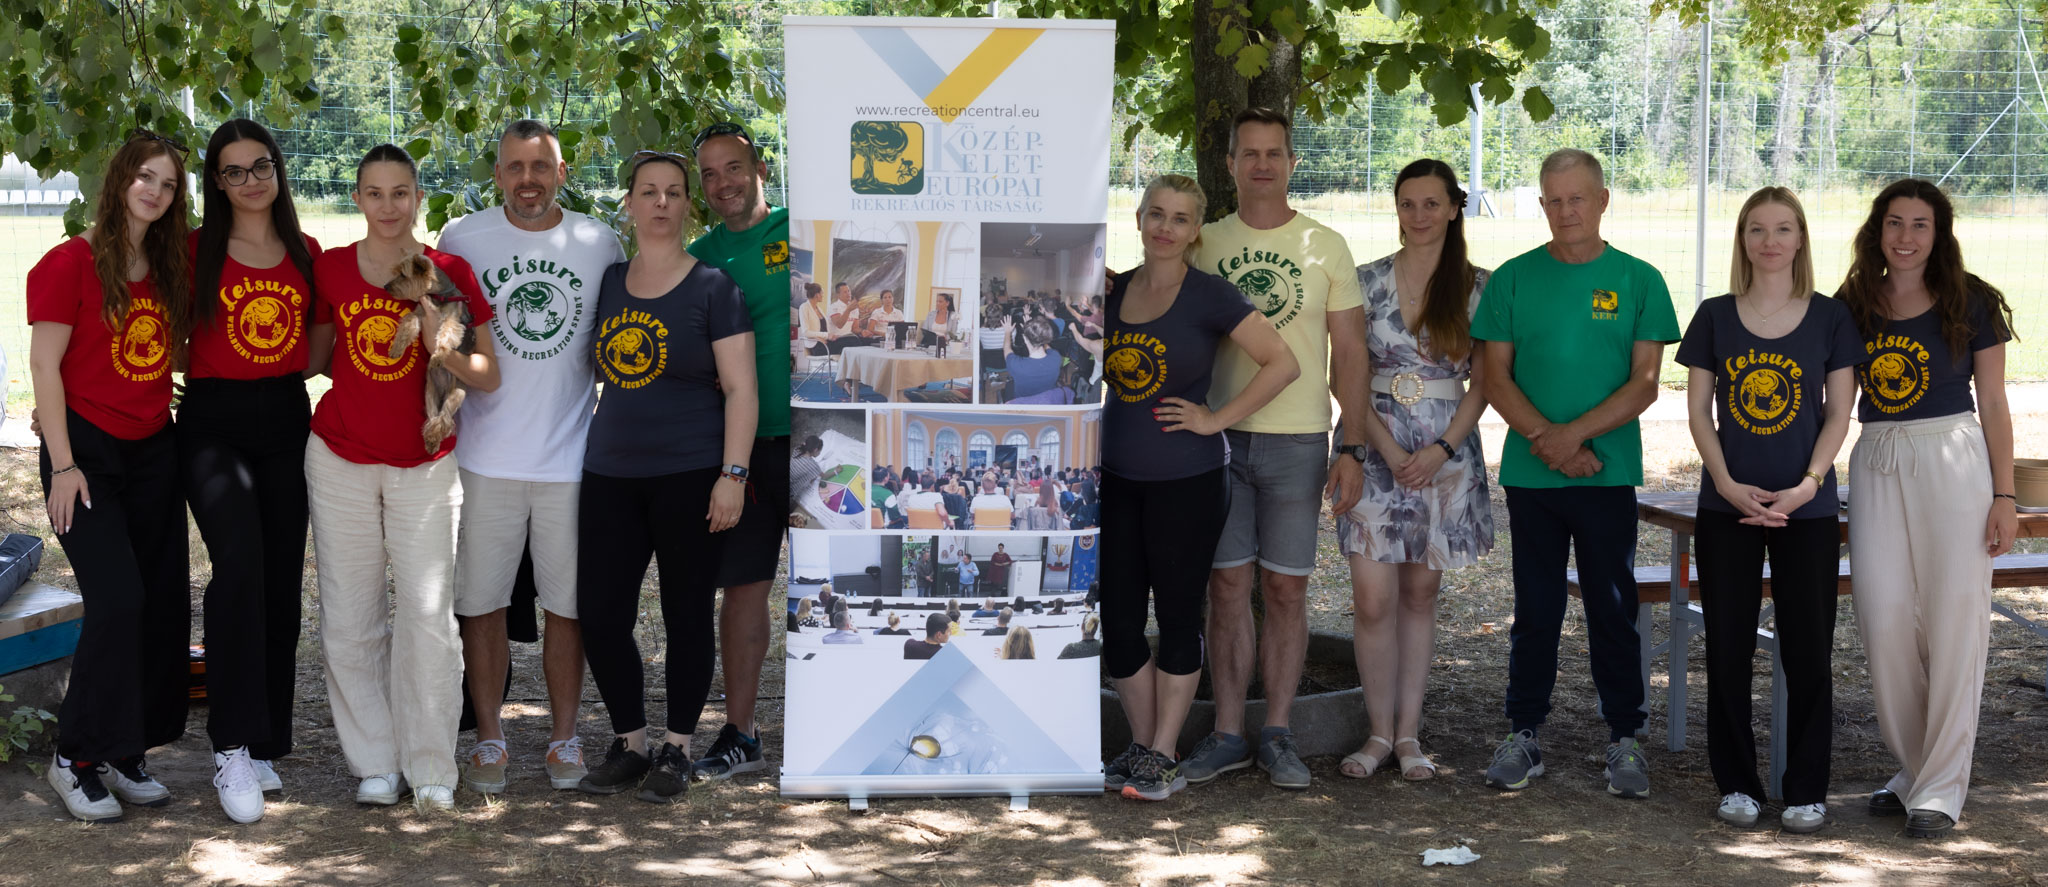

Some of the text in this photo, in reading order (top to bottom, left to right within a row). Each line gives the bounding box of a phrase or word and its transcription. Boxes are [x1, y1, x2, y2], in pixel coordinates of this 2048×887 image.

[855, 104, 1040, 118] www.recreationcentral.eu
[925, 175, 1044, 198] EURÓPAI
[851, 195, 1044, 213] REKREÁCIÓS TÁRSASÁG
[482, 255, 583, 298] Leisure
[1217, 247, 1302, 280] Leisure
[220, 277, 302, 312] Leisure
[339, 294, 413, 327] Leisur
[521, 329, 575, 361] RECREATION
[571, 296, 583, 329] SPORT
[599, 307, 669, 339] Leisure
[1592, 312, 1619, 321] KERT
[1103, 330, 1167, 356] eisure
[1865, 332, 1930, 364] eisure
[371, 355, 417, 382] RECREATION
[1725, 348, 1803, 382] Leisure
[1750, 409, 1797, 436] RECREATION
